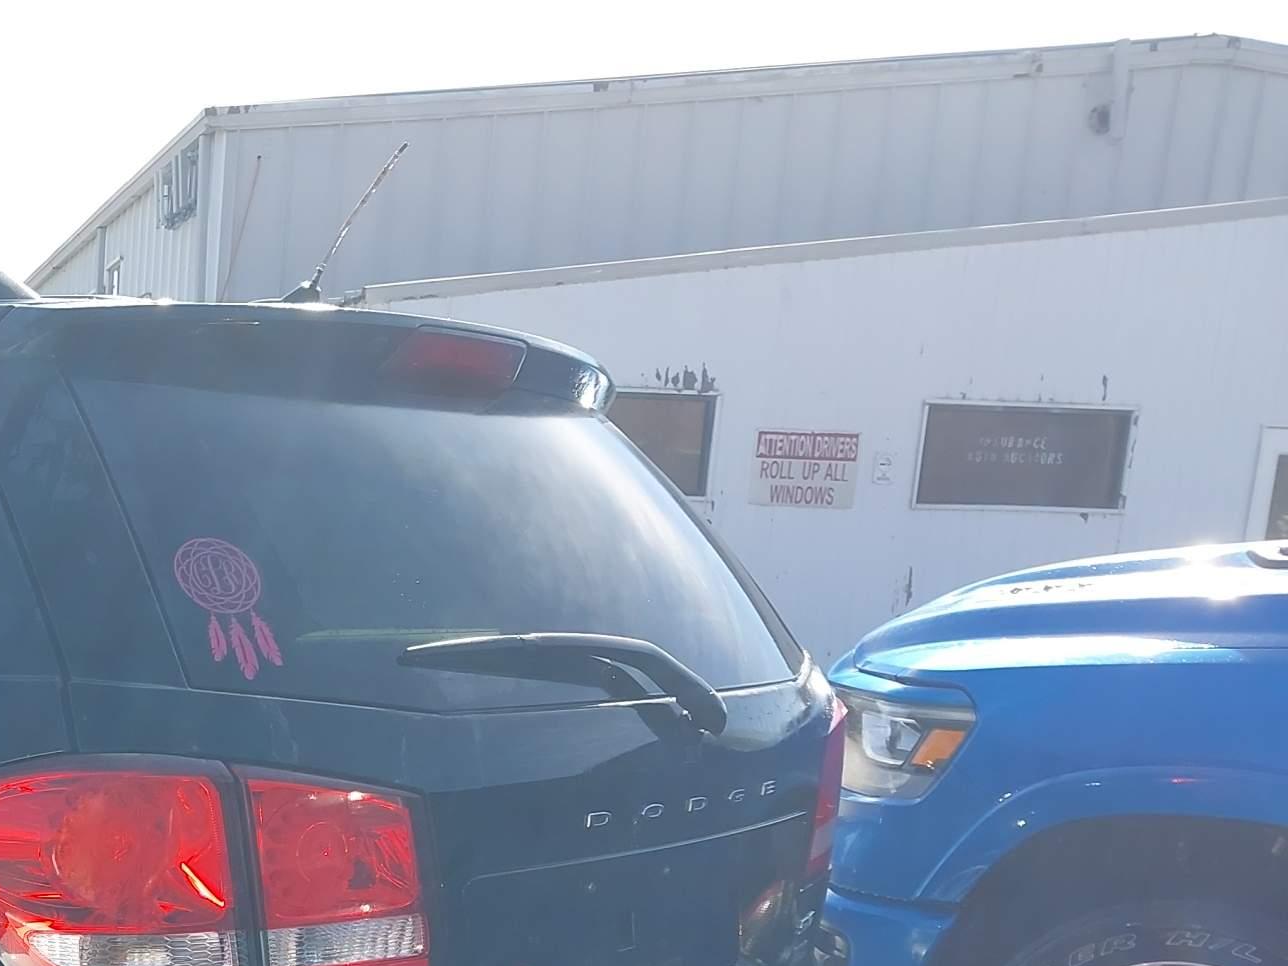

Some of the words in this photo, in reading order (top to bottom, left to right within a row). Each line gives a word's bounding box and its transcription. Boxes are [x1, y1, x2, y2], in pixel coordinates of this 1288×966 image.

[758, 434, 813, 458] ATTENTION
[814, 436, 857, 459] DRIVERS
[979, 436, 1048, 449] URACE
[760, 460, 794, 480] ROLL
[802, 462, 820, 481] UP
[824, 463, 848, 482] ALL
[770, 485, 834, 505] WINDOWS
[585, 780, 776, 828] DODGE
